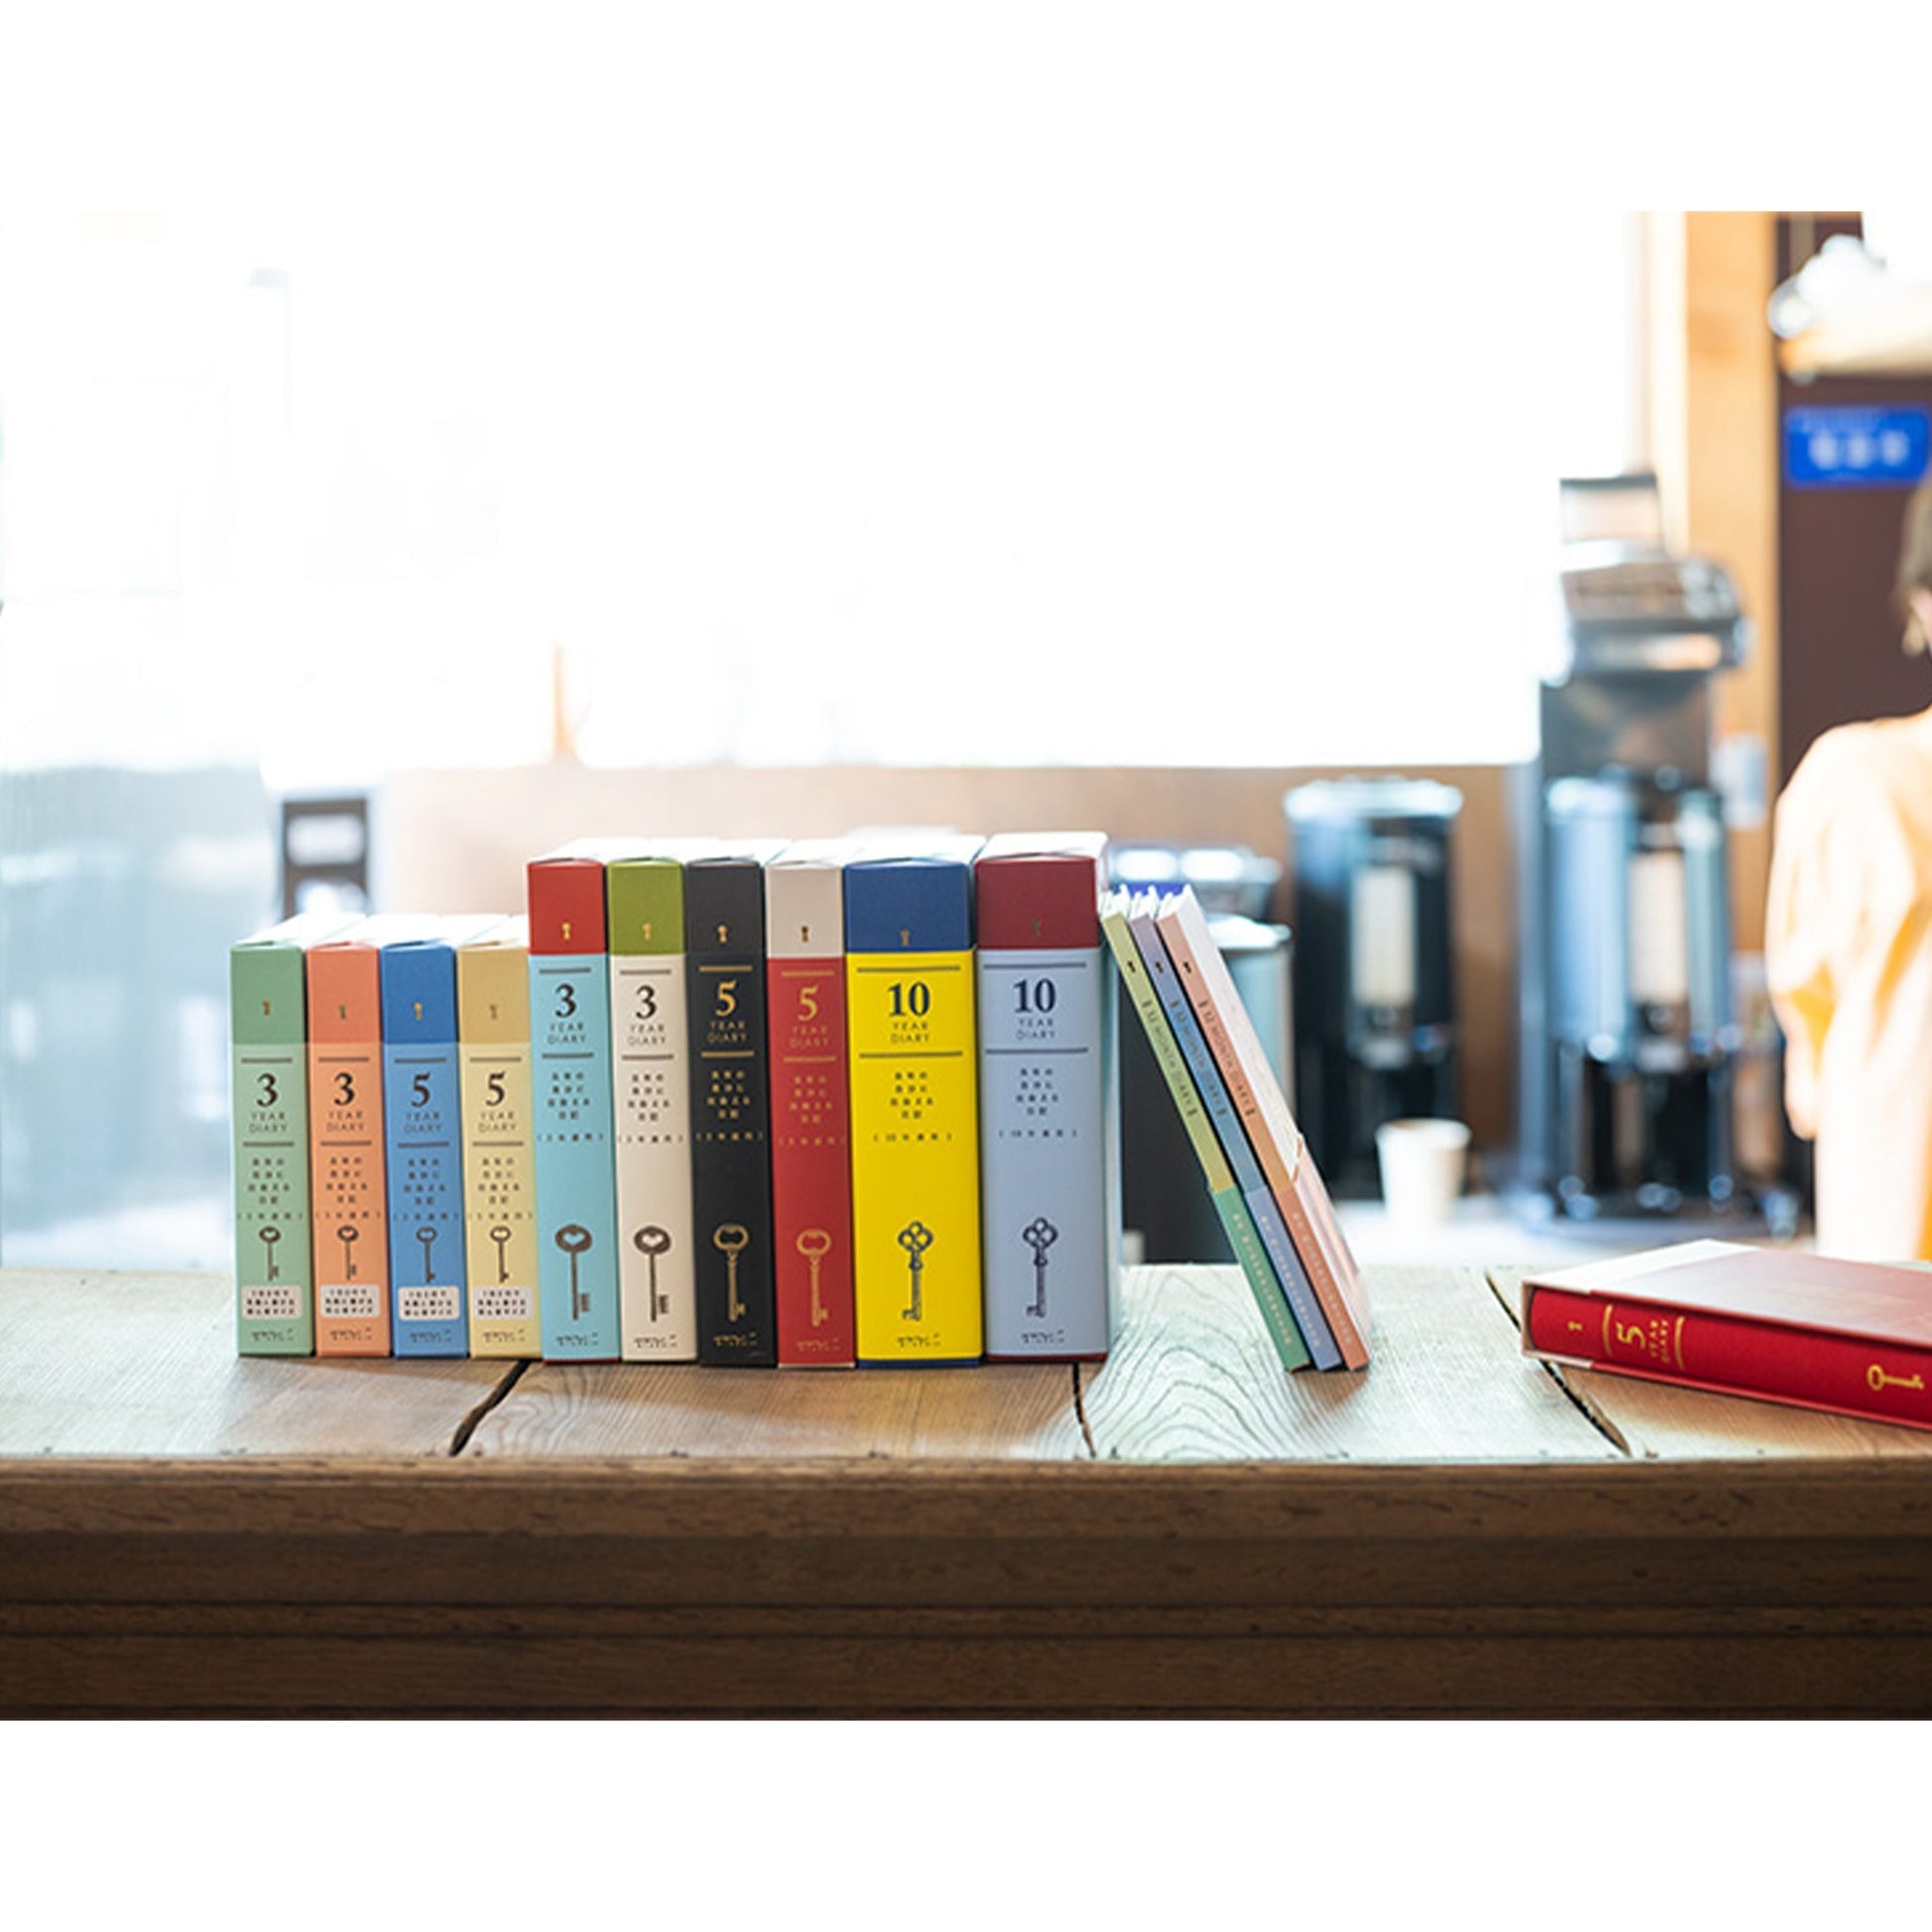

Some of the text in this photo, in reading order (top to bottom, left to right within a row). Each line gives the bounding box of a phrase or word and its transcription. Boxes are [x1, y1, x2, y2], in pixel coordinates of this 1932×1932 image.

[715, 980, 737, 1017] 5
[888, 981, 930, 1017] 10
[1014, 978, 1056, 1013] 10
[555, 983, 577, 1018] 3
[635, 985, 657, 1020] 3
[798, 985, 818, 1021] 5
[631, 1024, 664, 1033] YEAR
[709, 1021, 745, 1030] YEAR
[894, 1022, 927, 1031] YEAR
[548, 1035, 586, 1044] DIARY
[707, 1033, 747, 1042] DIARY
[1016, 1031, 1054, 1040] DIARY
[627, 1036, 665, 1045] DIARY
[256, 1072, 278, 1108] 3
[334, 1072, 355, 1106] 3
[411, 1070, 431, 1108] 5
[485, 1070, 505, 1106] 5
[329, 1111, 362, 1120] YEAR
[249, 1124, 286, 1133] DIARY
[327, 1123, 363, 1132] DIARY
[404, 1124, 442, 1133] DIARY
[479, 1123, 516, 1132] DIARY
[1616, 1320, 1646, 1348] 5
